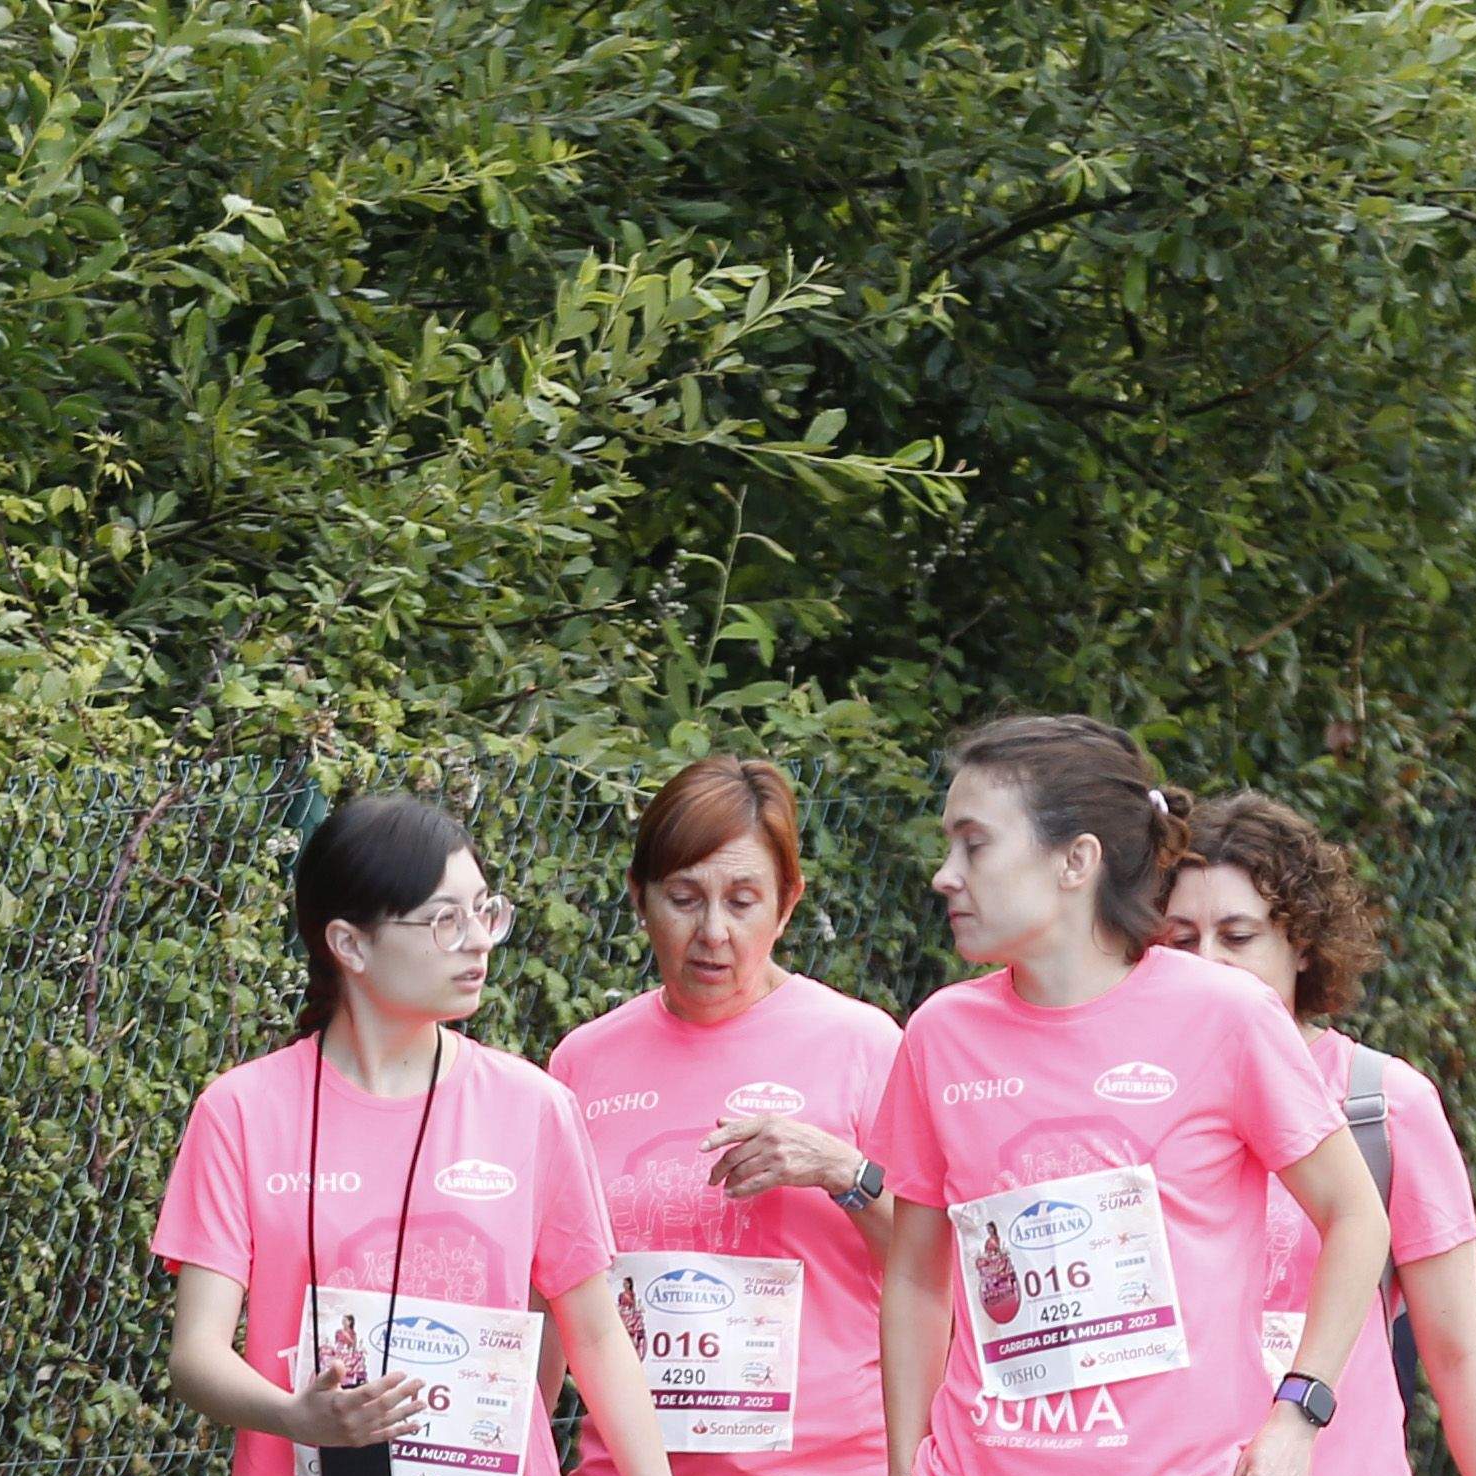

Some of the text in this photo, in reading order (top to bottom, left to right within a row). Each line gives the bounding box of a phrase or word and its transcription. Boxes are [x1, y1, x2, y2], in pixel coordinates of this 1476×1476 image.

[943, 1077, 1023, 1105] OYSHO
[585, 1090, 659, 1120] OYSHO
[266, 1171, 361, 1194] OYSHO
[1099, 1195, 1143, 1212] SUMA
[1014, 1217, 1085, 1242] ASTURIANA
[743, 1284, 785, 1296] SUMA
[1024, 1261, 1091, 1297] 016
[652, 1287, 727, 1306] ASTURIANA
[1040, 1301, 1083, 1324] 4292
[376, 1329, 461, 1356] ASTURIANA
[479, 1337, 522, 1351] SUMA
[652, 1331, 720, 1358] 016
[998, 1314, 1158, 1356] CARRERA DE LA MUJER 2023
[1098, 1342, 1167, 1366] Santander
[661, 1368, 706, 1385] 4290
[1001, 1364, 1047, 1388] OYSHO
[660, 1395, 677, 1405] DE
[680, 1396, 694, 1406] LA
[697, 1396, 740, 1406] MUJER
[744, 1396, 773, 1407] 2023
[970, 1383, 1125, 1433] SUMA
[710, 1422, 776, 1436] Santander
[1096, 1434, 1129, 1447] 2023
[401, 1447, 419, 1458] LA
[424, 1448, 467, 1464] MUJER
[470, 1453, 502, 1468] 2023
